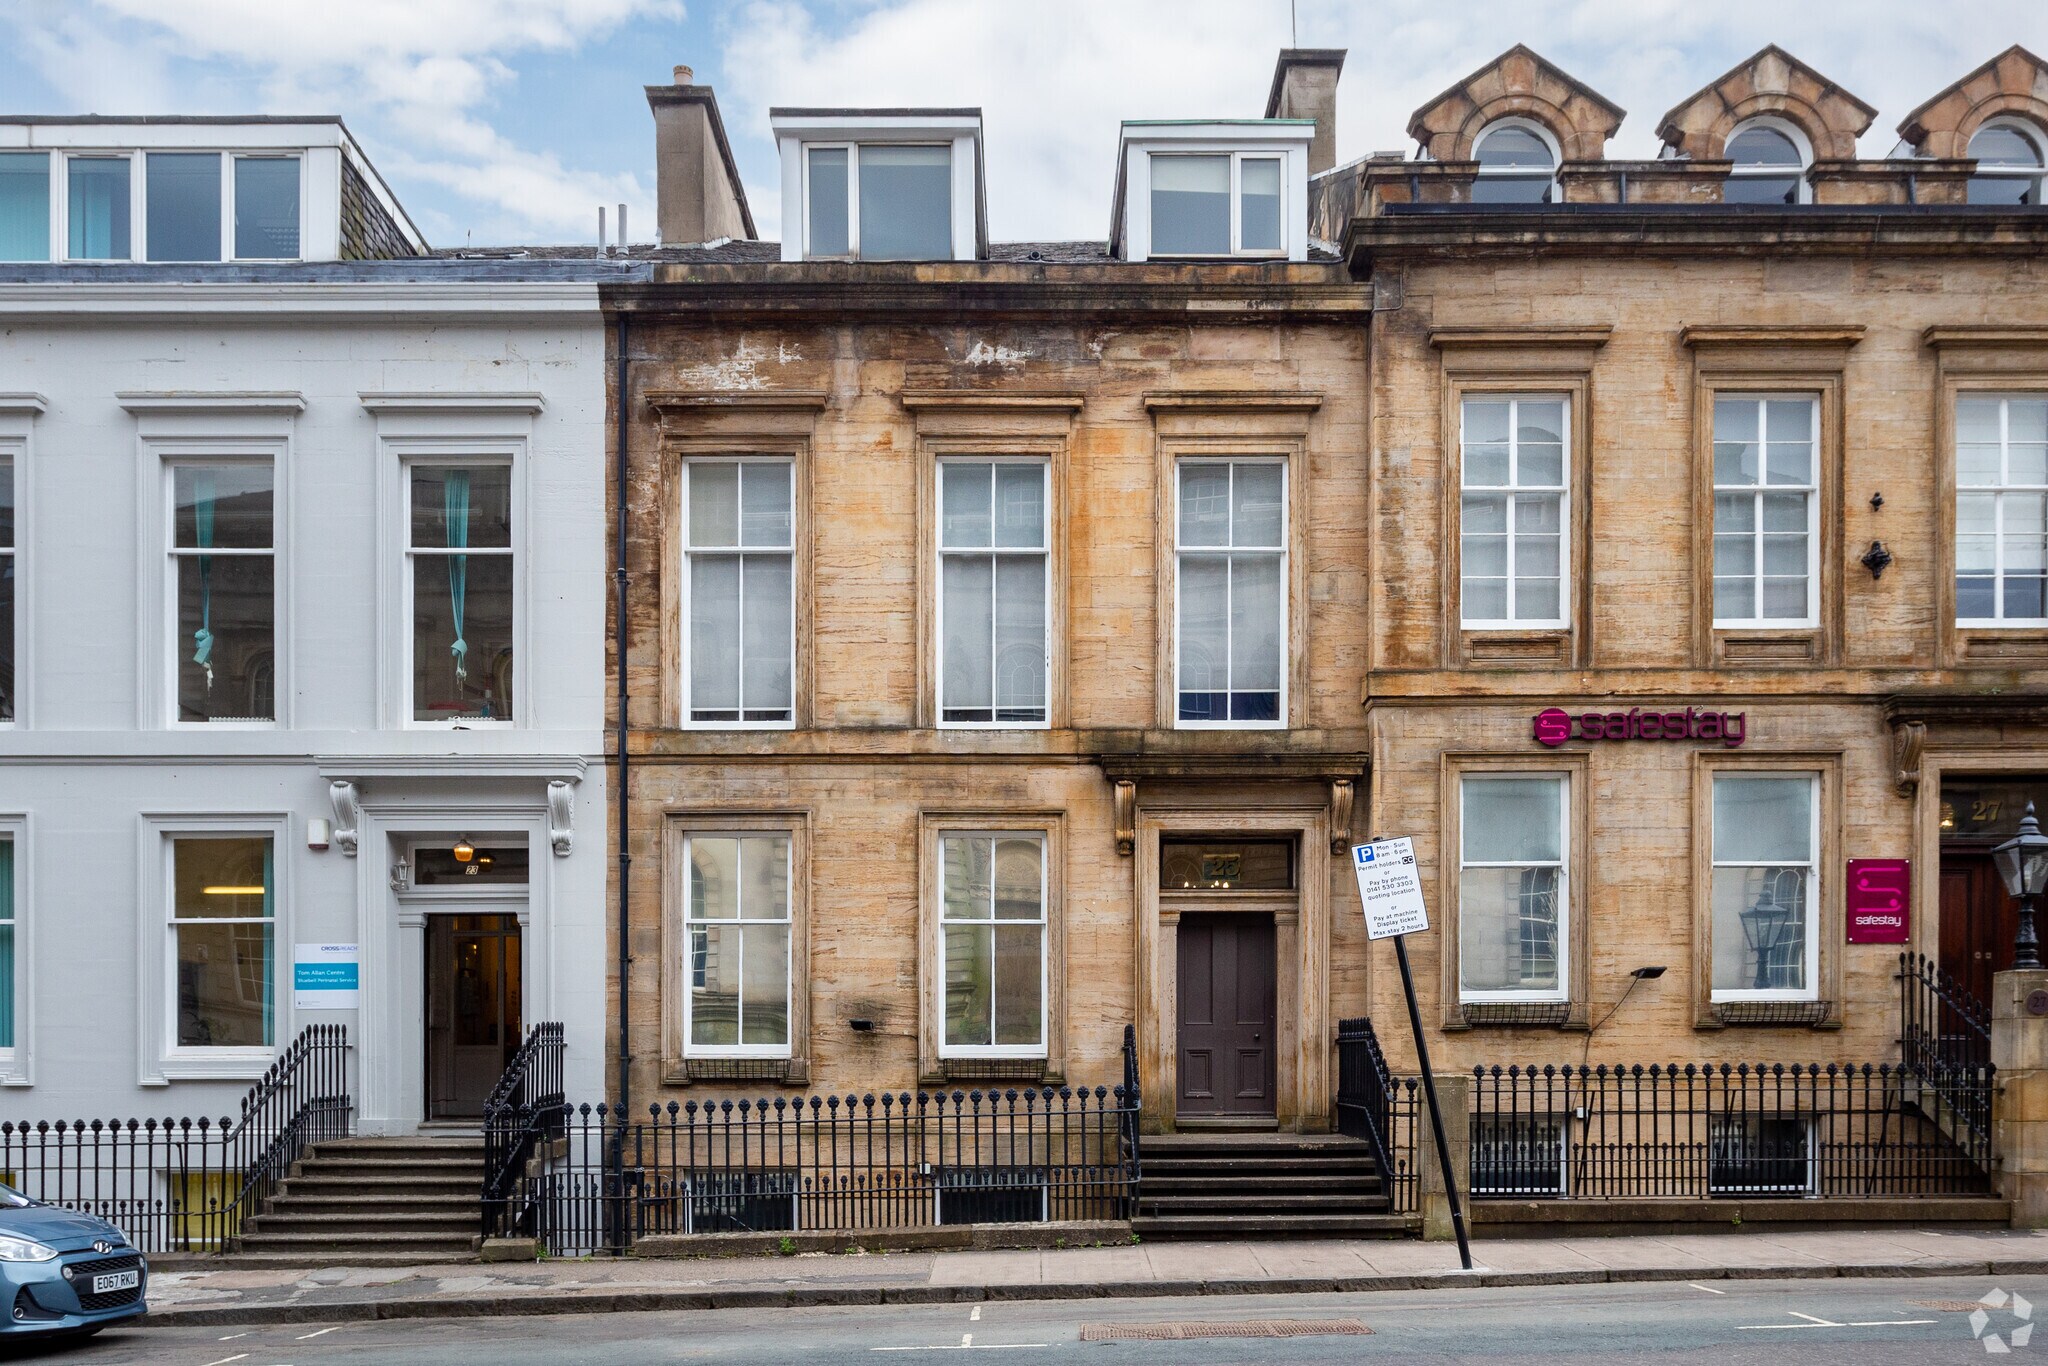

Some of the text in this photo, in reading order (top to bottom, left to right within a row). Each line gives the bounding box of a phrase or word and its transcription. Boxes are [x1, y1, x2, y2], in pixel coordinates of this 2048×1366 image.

[1580, 707, 1746, 747] safestay
[1971, 800, 2003, 821] 27
[1361, 847, 1372, 862] P
[466, 866, 478, 874] 23
[1210, 855, 1241, 877] 25
[1379, 860, 1401, 868] holders
[1381, 883, 1395, 891] 530
[1396, 880, 1414, 888] 3303
[1392, 888, 1415, 896] location
[1377, 920, 1398, 928] Display
[1855, 915, 1902, 928] safestay
[2033, 996, 2047, 1008] 27
[120, 1272, 136, 1286] RKU
